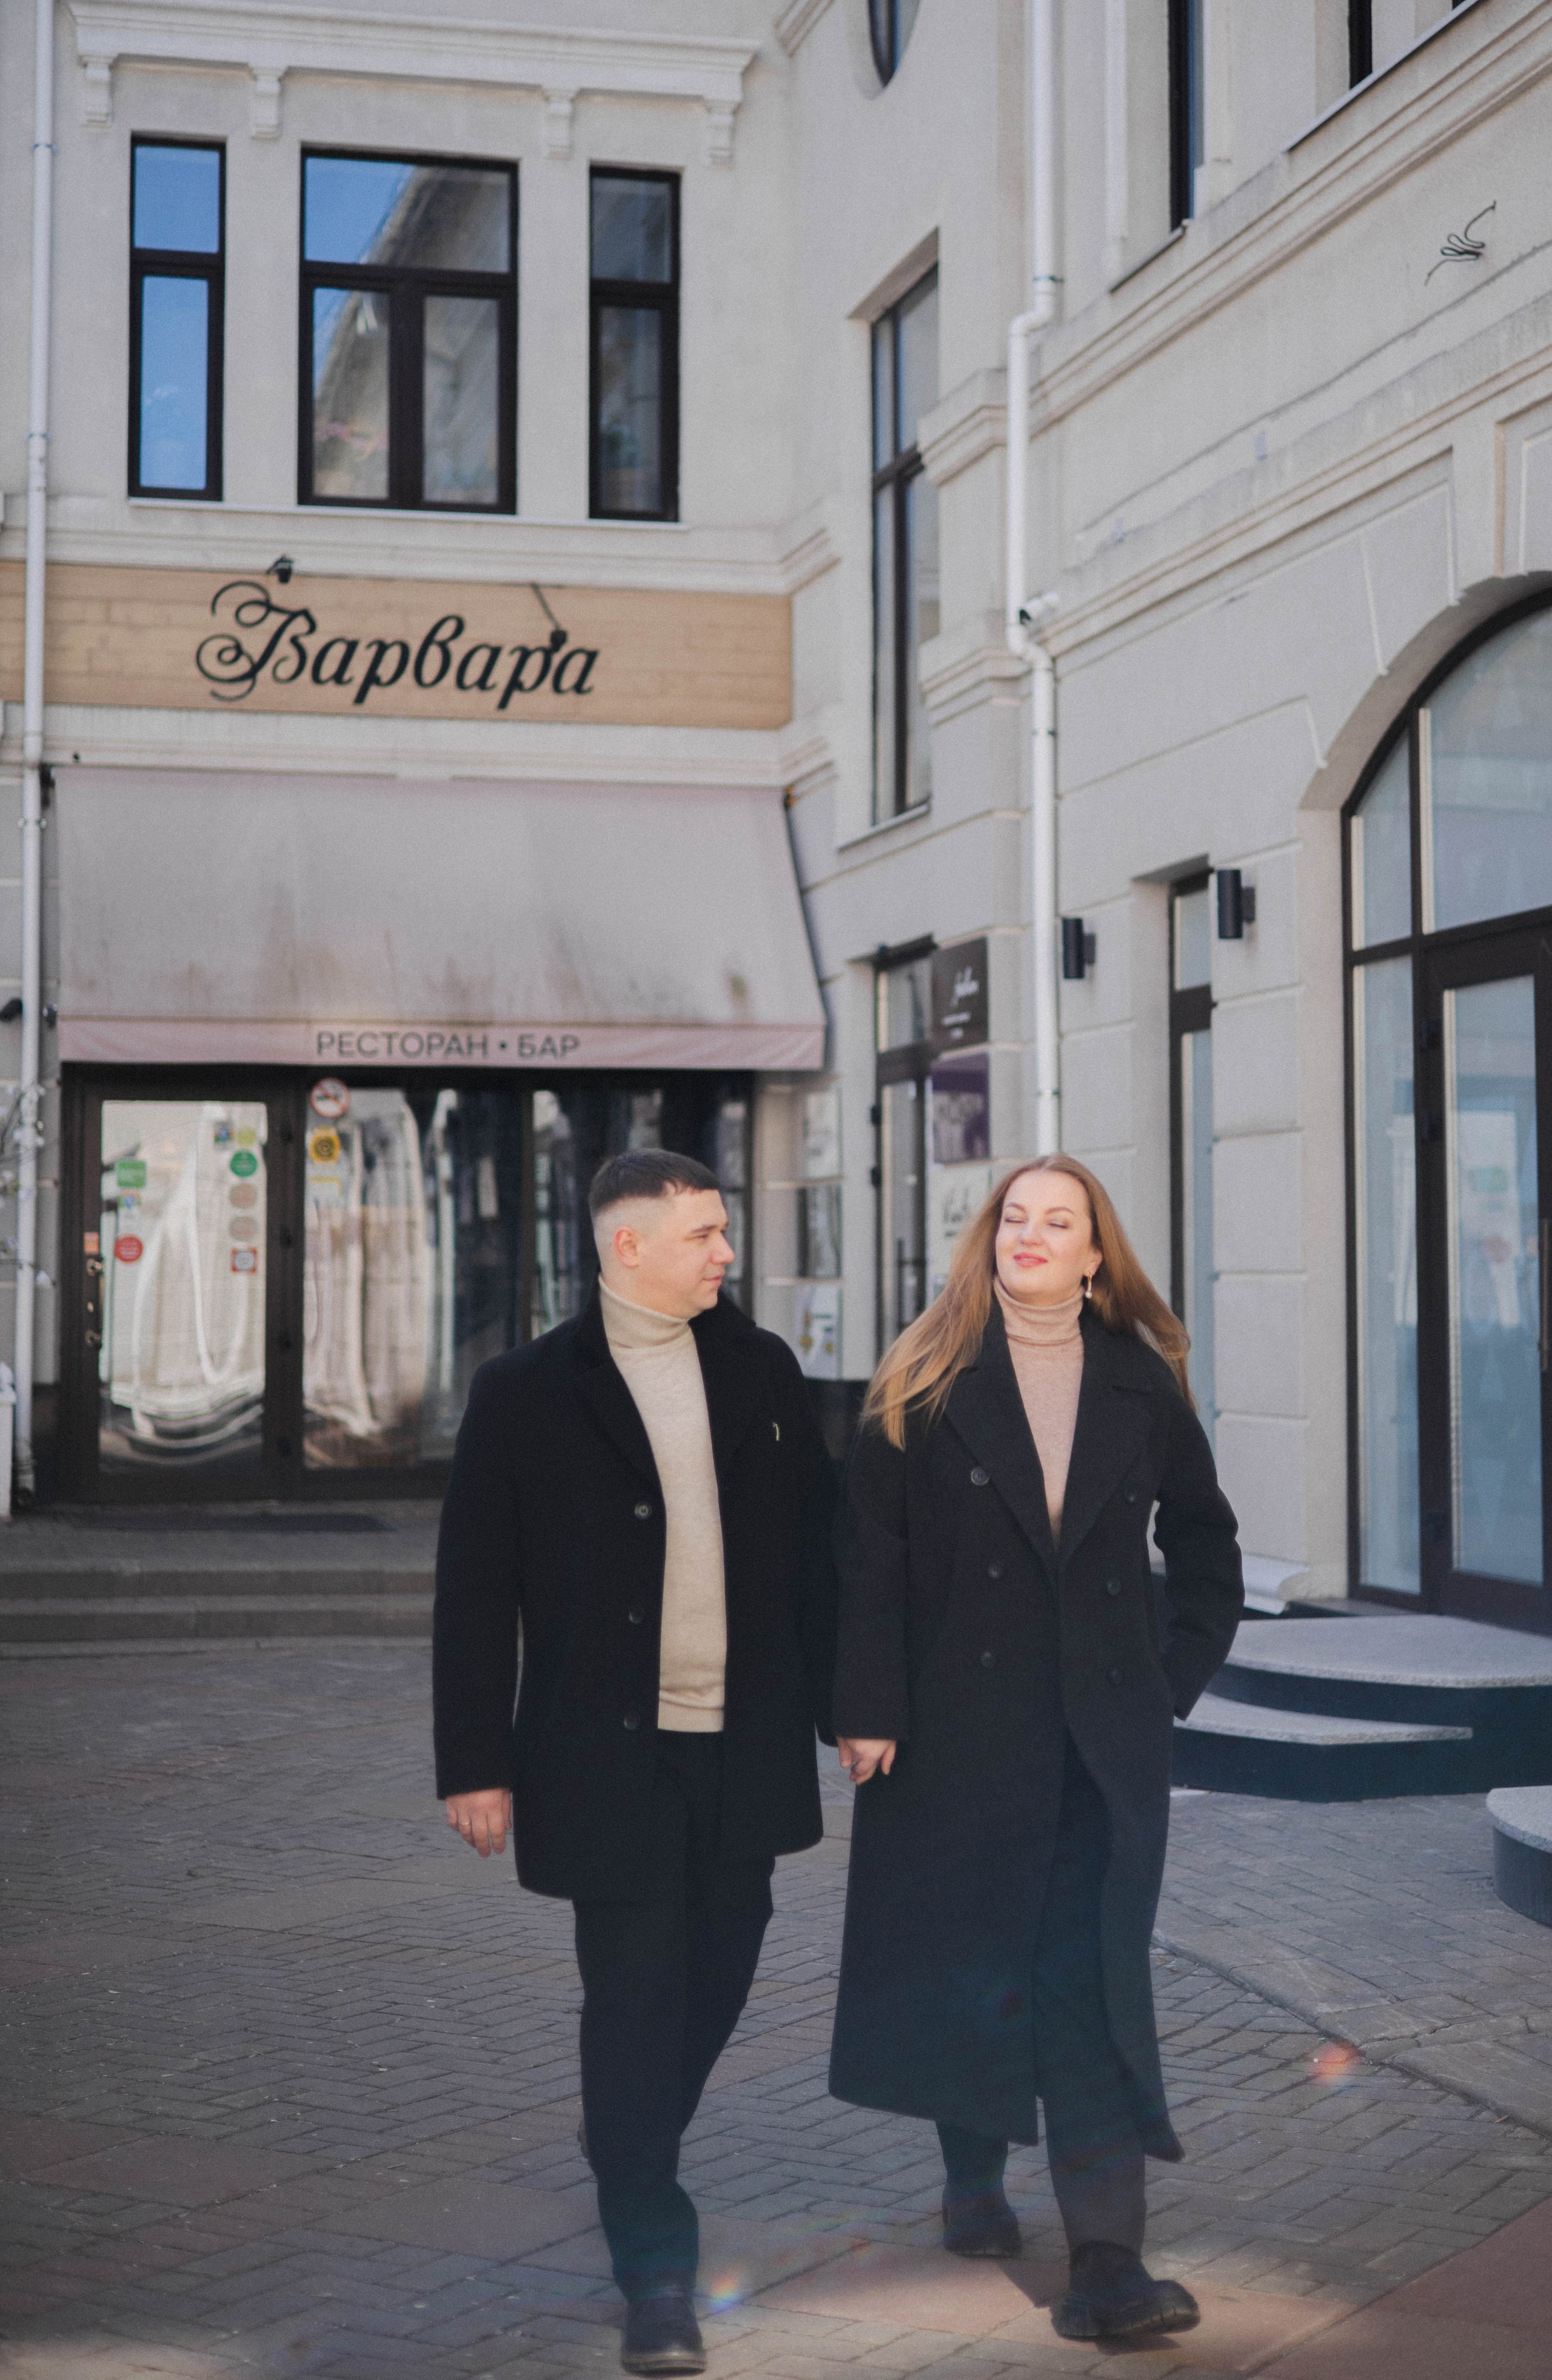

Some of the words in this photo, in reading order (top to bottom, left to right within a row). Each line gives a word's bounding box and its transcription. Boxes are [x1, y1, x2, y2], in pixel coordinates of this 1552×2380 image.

[196, 581, 600, 710] Варвара
[317, 1032, 487, 1058] РЕСТОРАН
[518, 1033, 580, 1059] БАР
